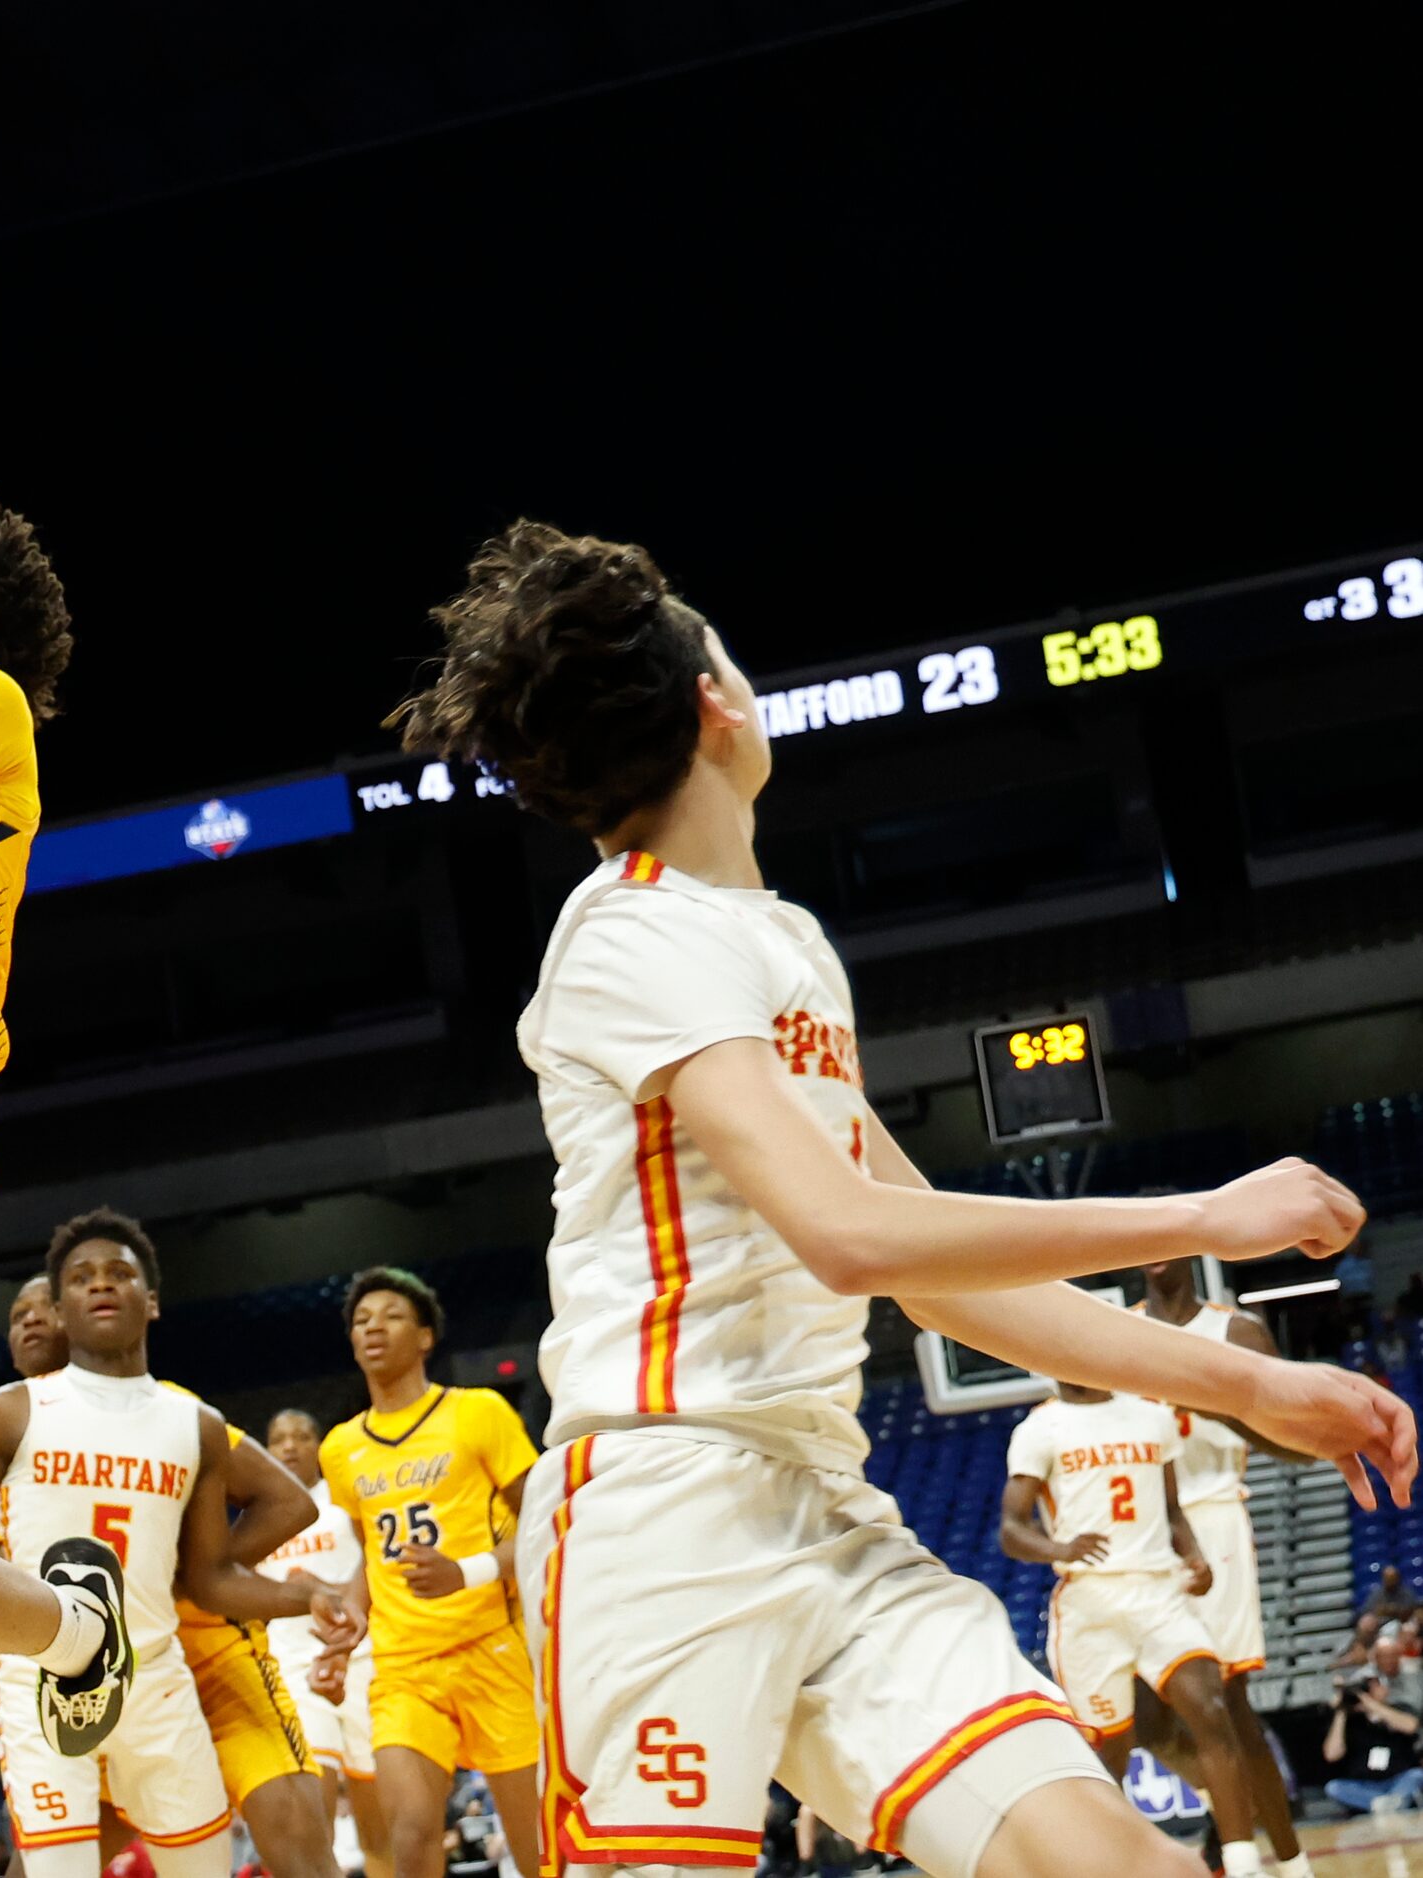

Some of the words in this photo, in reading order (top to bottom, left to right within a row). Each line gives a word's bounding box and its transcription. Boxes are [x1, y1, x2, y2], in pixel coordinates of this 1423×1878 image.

[1338, 577, 1377, 621] 3
[1042, 615, 1163, 687] 5:33
[754, 669, 904, 738] TAFFORD
[917, 645, 999, 714] 23
[357, 781, 412, 812] TOL
[418, 762, 455, 802] 4
[1009, 1023, 1085, 1070] 5:32
[33, 1450, 188, 1500] SPARTANS
[1109, 1475, 1136, 1522] 2
[92, 1502, 132, 1571] 5
[376, 1502, 440, 1560] 25
